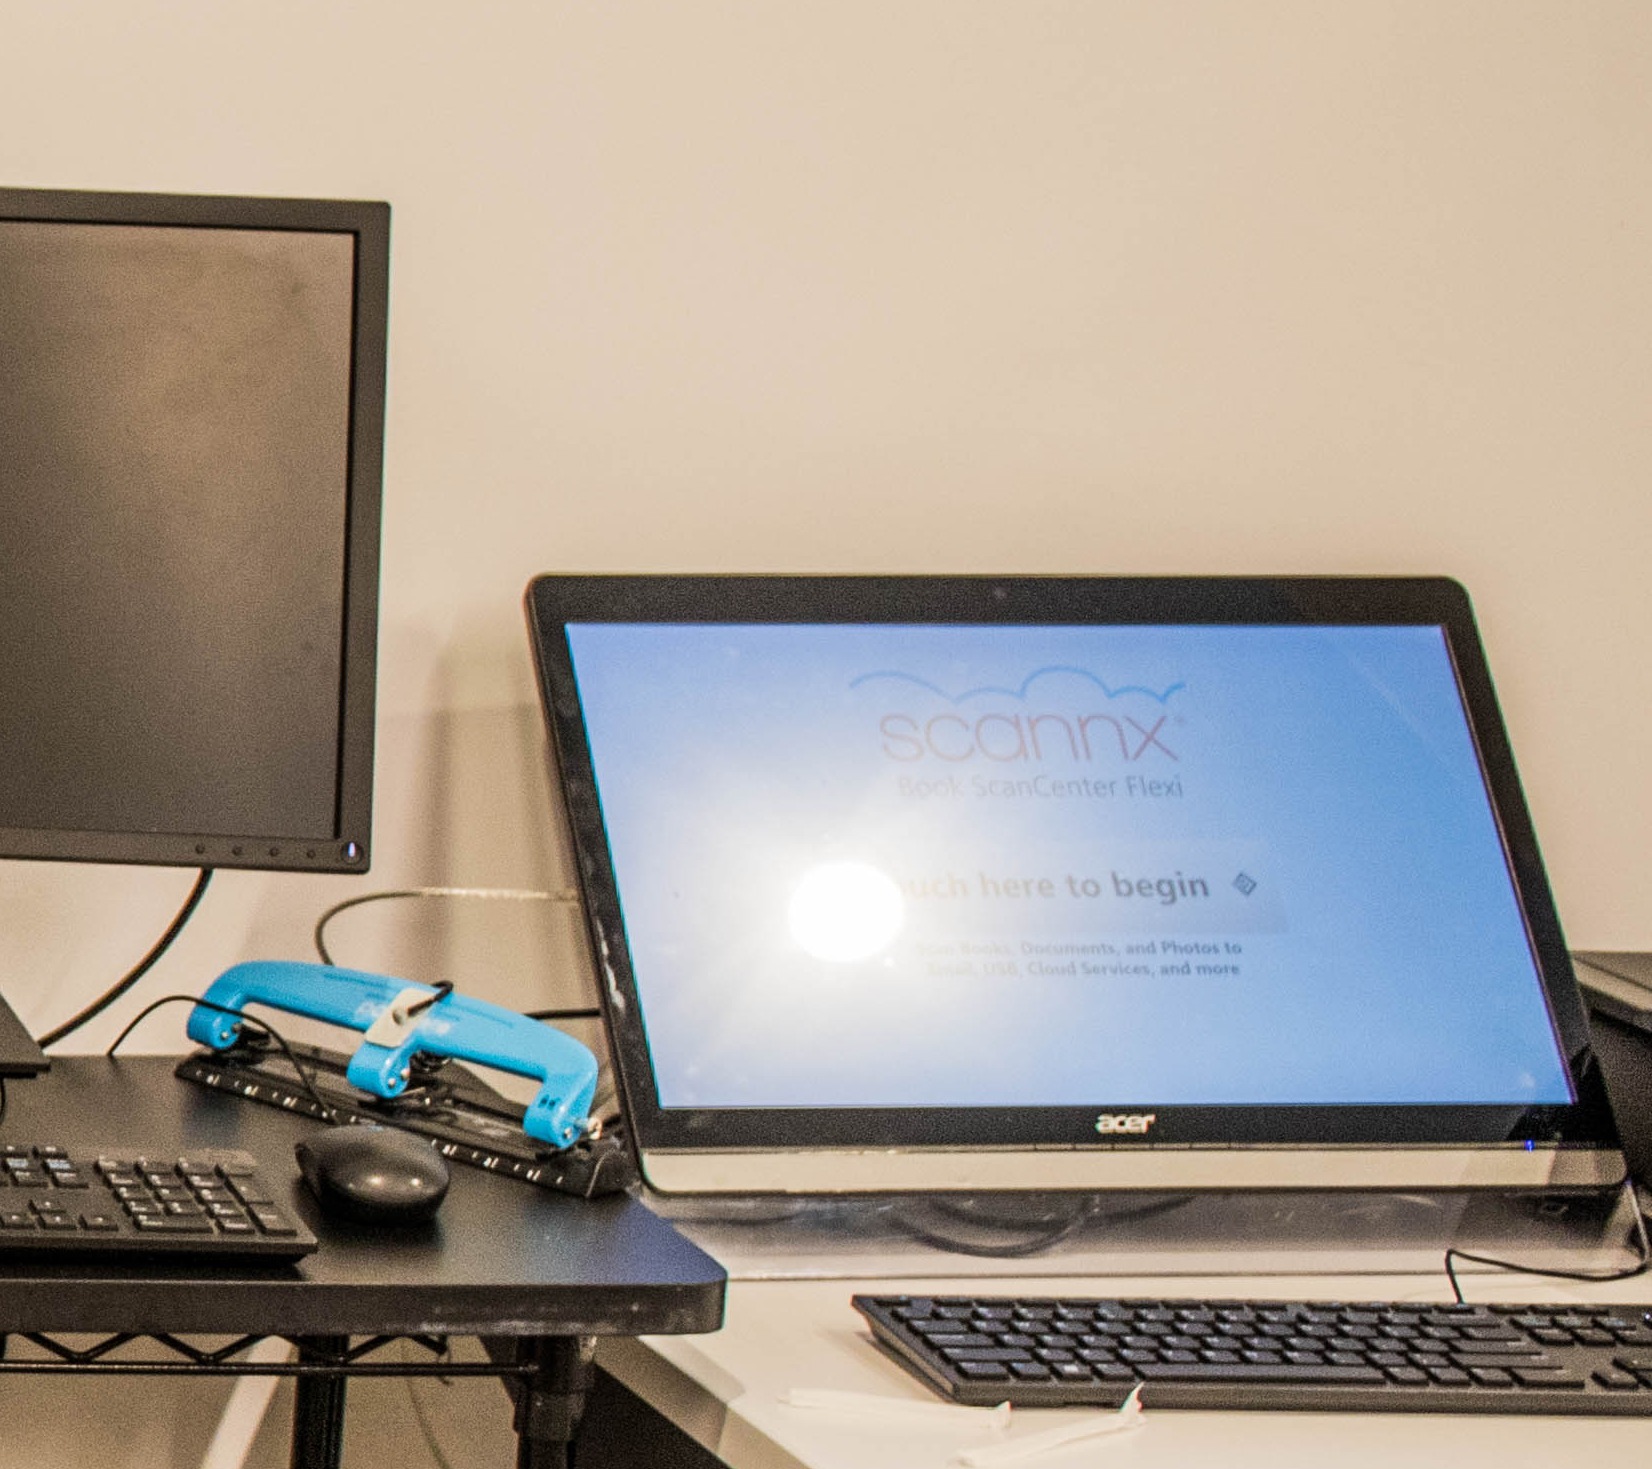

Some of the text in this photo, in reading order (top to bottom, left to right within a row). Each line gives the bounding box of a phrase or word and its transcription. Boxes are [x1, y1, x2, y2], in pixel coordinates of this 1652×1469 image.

[880, 713, 1179, 763] scannx
[898, 775, 1183, 798] Book ScanCenter Flexi
[893, 870, 1209, 905] ouch here to begin
[1021, 942, 1116, 957] Documents,
[1125, 941, 1156, 955] and
[1161, 941, 1220, 956] Photos
[1224, 943, 1242, 956] to
[1027, 962, 1077, 976] Cloud
[1081, 962, 1154, 978] Services,
[1160, 962, 1191, 976] and
[1196, 963, 1240, 976] more
[1095, 1114, 1156, 1134] acer
